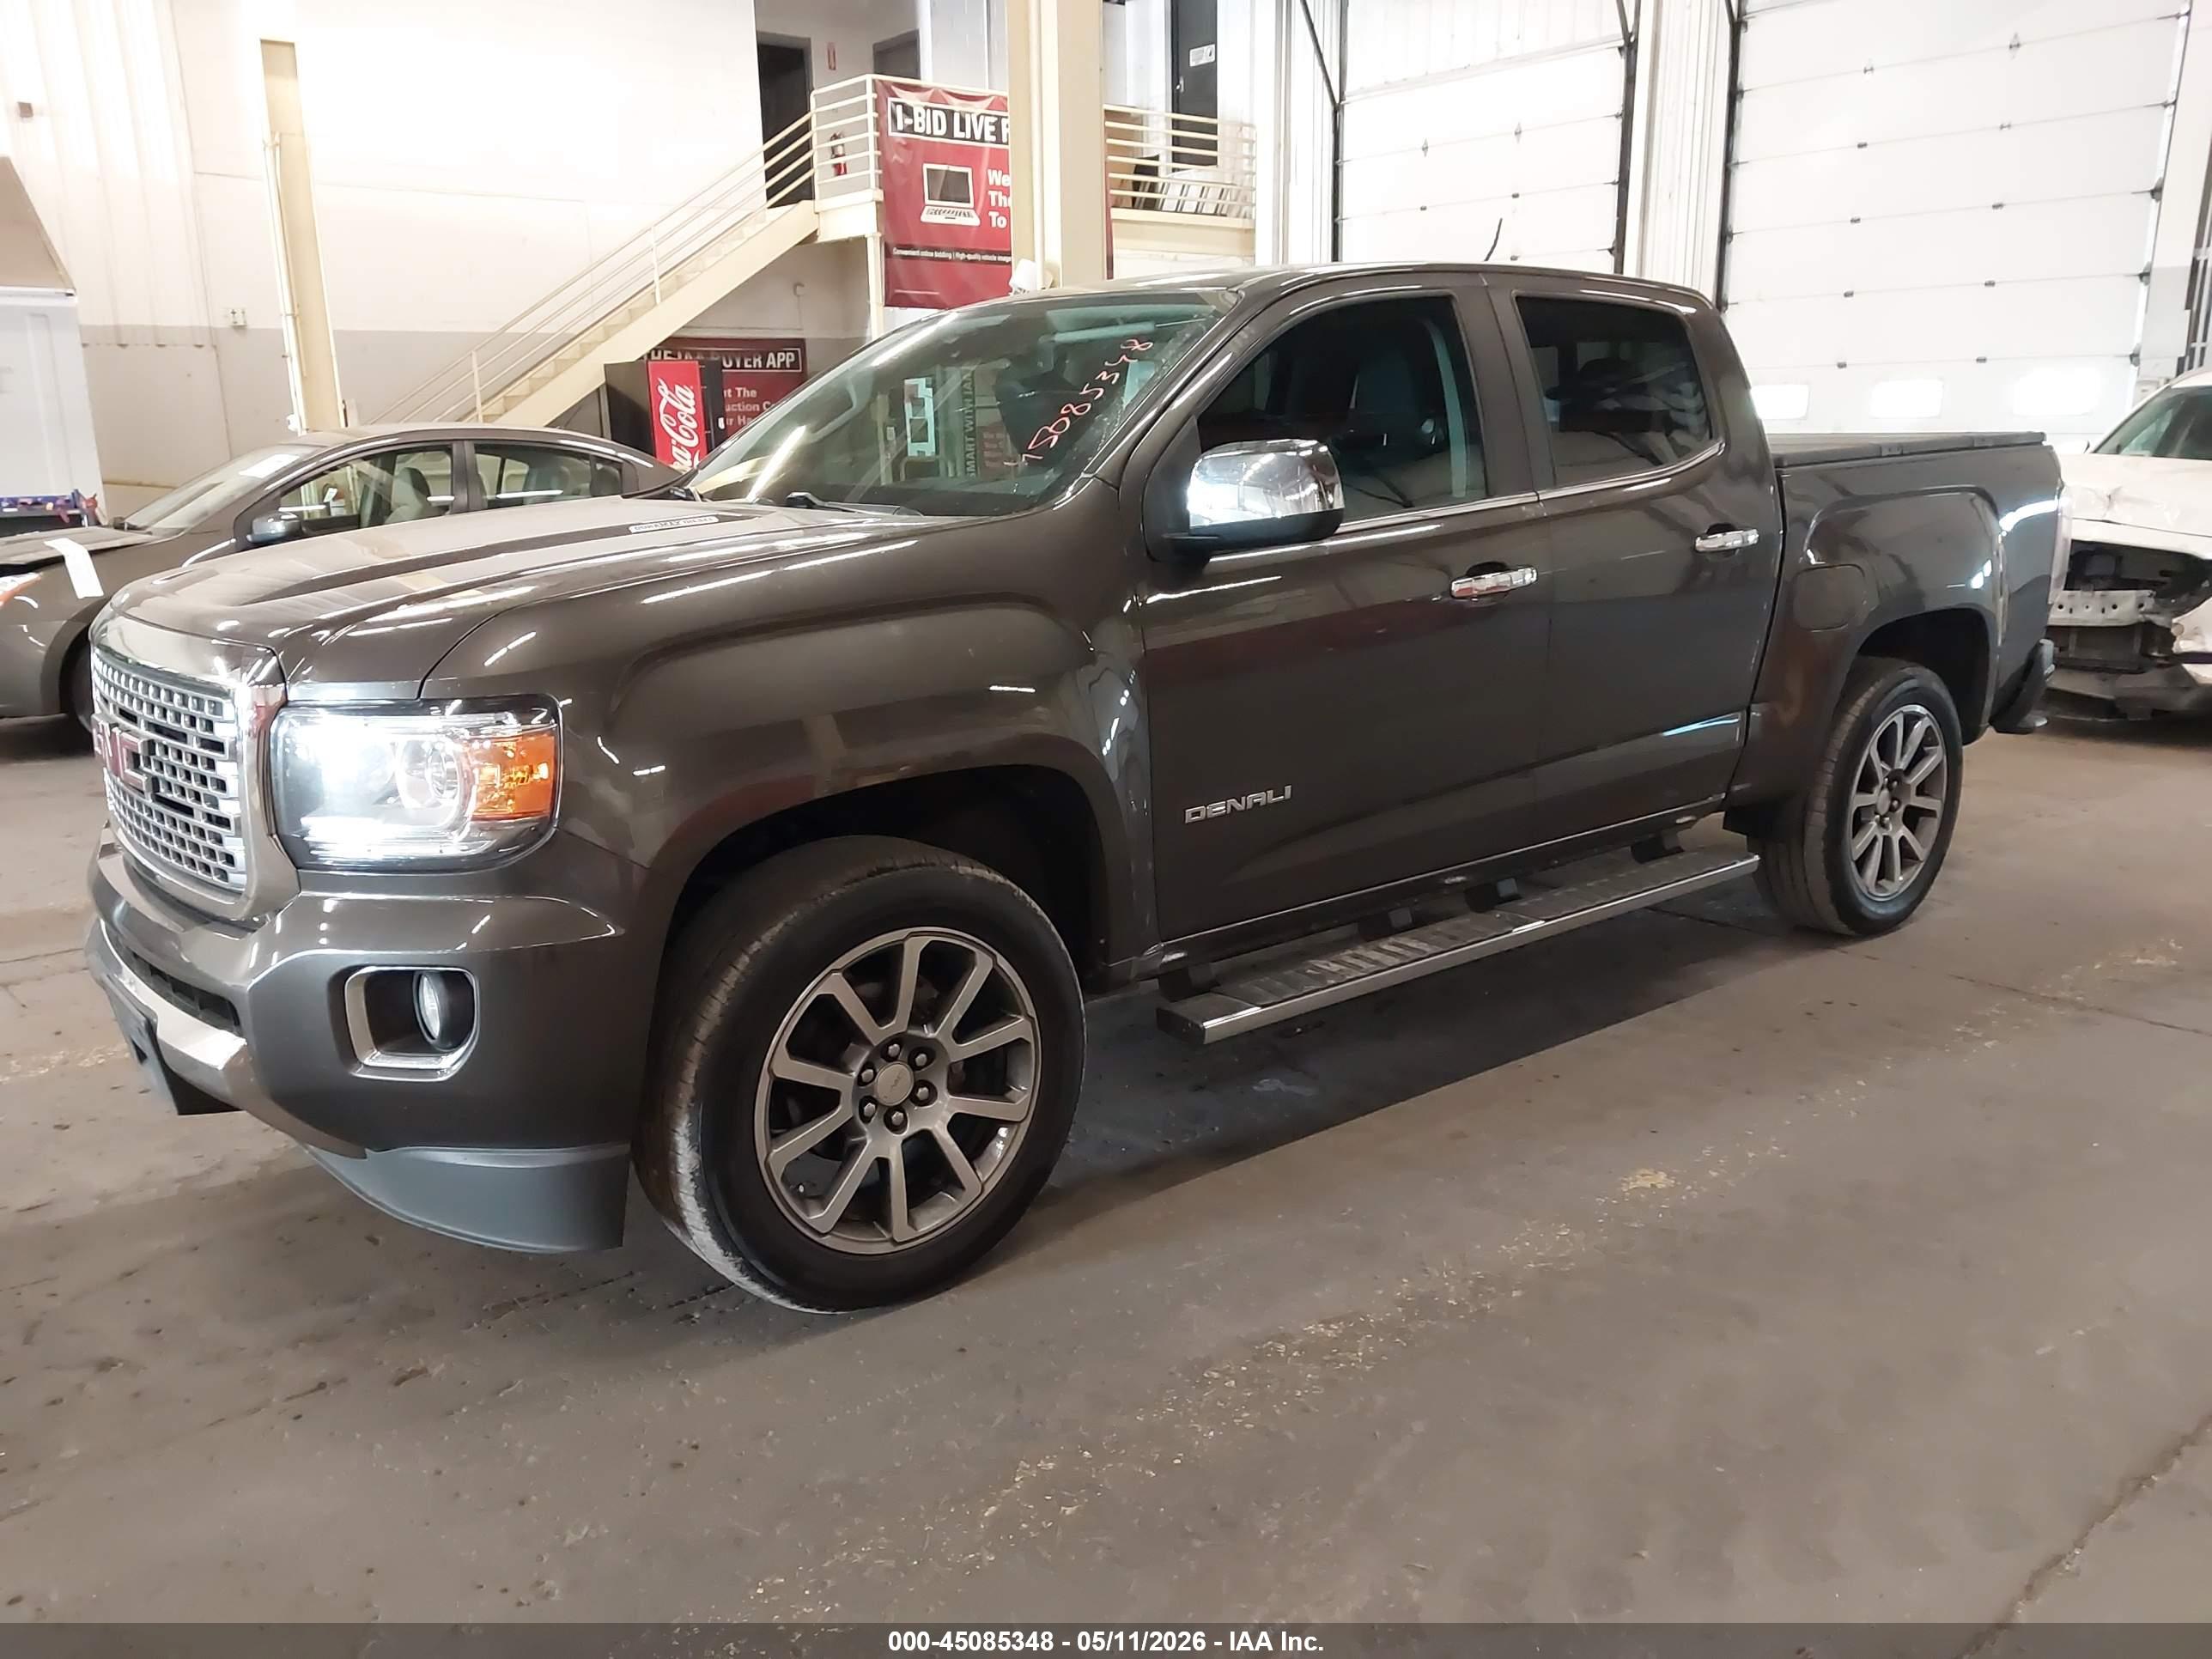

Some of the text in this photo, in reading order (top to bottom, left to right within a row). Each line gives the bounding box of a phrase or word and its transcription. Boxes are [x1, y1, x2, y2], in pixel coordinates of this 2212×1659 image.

[896, 104, 947, 136] I-BID
[953, 112, 999, 142] LIVE
[988, 190, 1011, 208] Th
[988, 211, 1007, 228] To
[766, 352, 796, 368] APP
[735, 386, 757, 398] The
[726, 401, 760, 412] uction
[1185, 785, 1291, 823] DENALI
